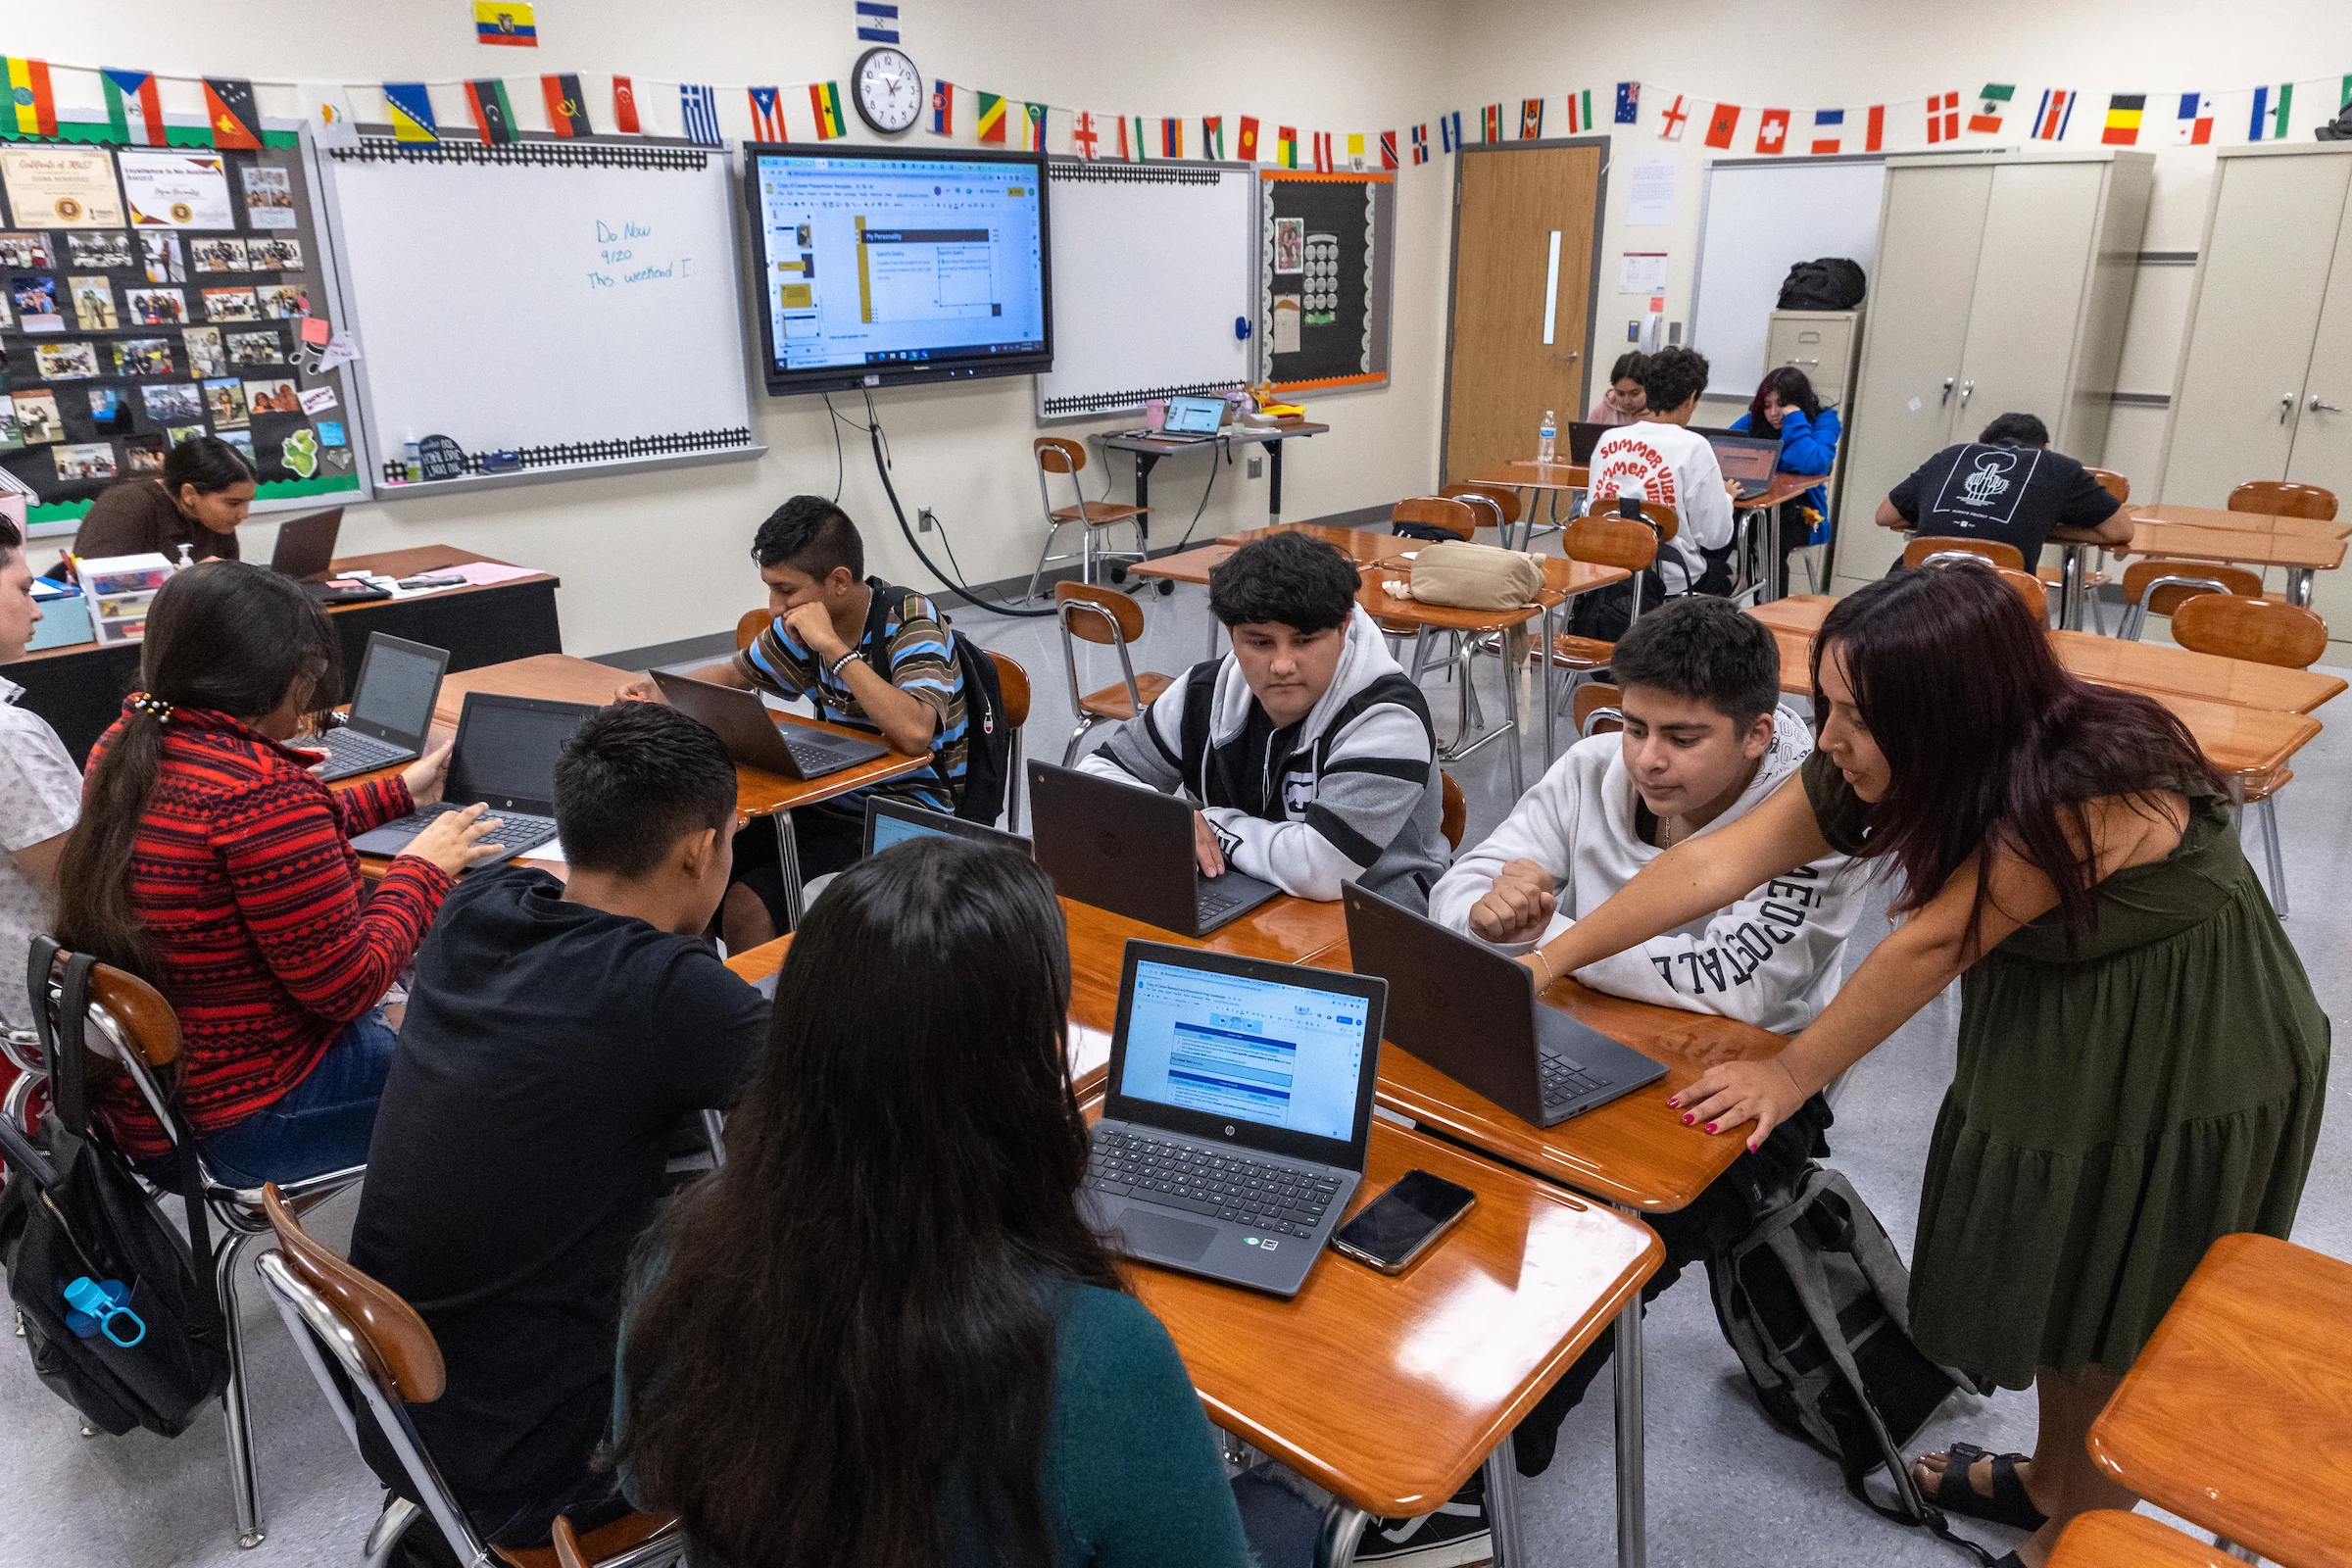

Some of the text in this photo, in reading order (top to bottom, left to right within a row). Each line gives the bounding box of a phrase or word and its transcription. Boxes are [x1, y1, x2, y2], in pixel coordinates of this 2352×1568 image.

[597, 220, 651, 243] Do Now
[602, 249, 633, 265] 9/20
[587, 270, 614, 289] This
[624, 262, 673, 283] weekend
[1224, 1124, 1236, 1136] hp
